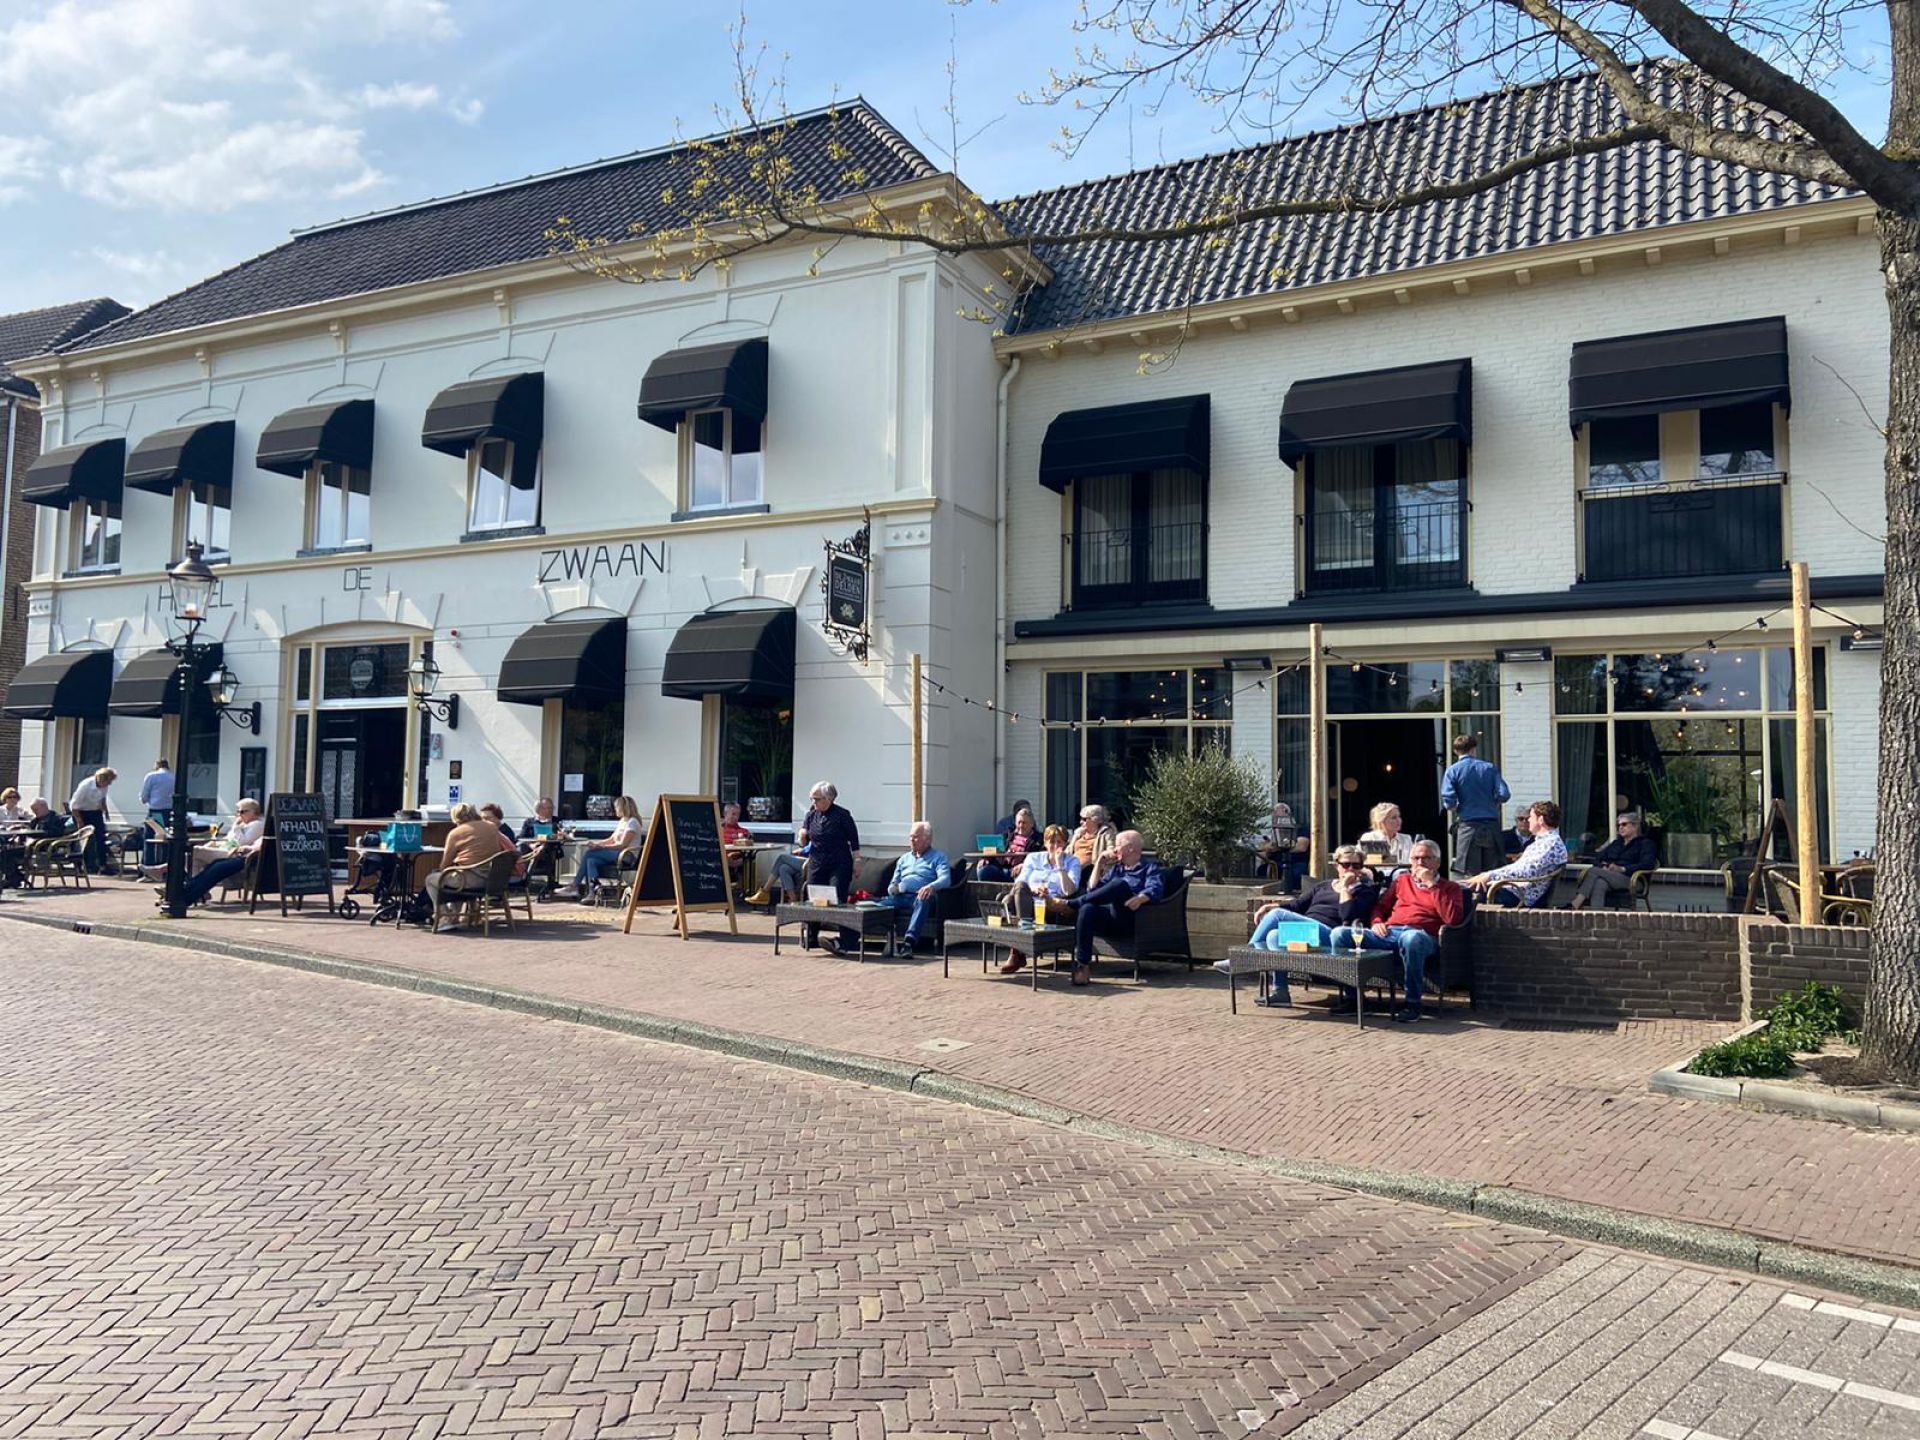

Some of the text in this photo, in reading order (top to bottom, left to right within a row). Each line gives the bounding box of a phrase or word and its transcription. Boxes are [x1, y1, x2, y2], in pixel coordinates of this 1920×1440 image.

[158, 540, 665, 612] HEL DE ZWAAN
[834, 579, 861, 595] DELDEN
[280, 820, 324, 834] AFHALEN
[280, 840, 326, 852] BEZORGEN
